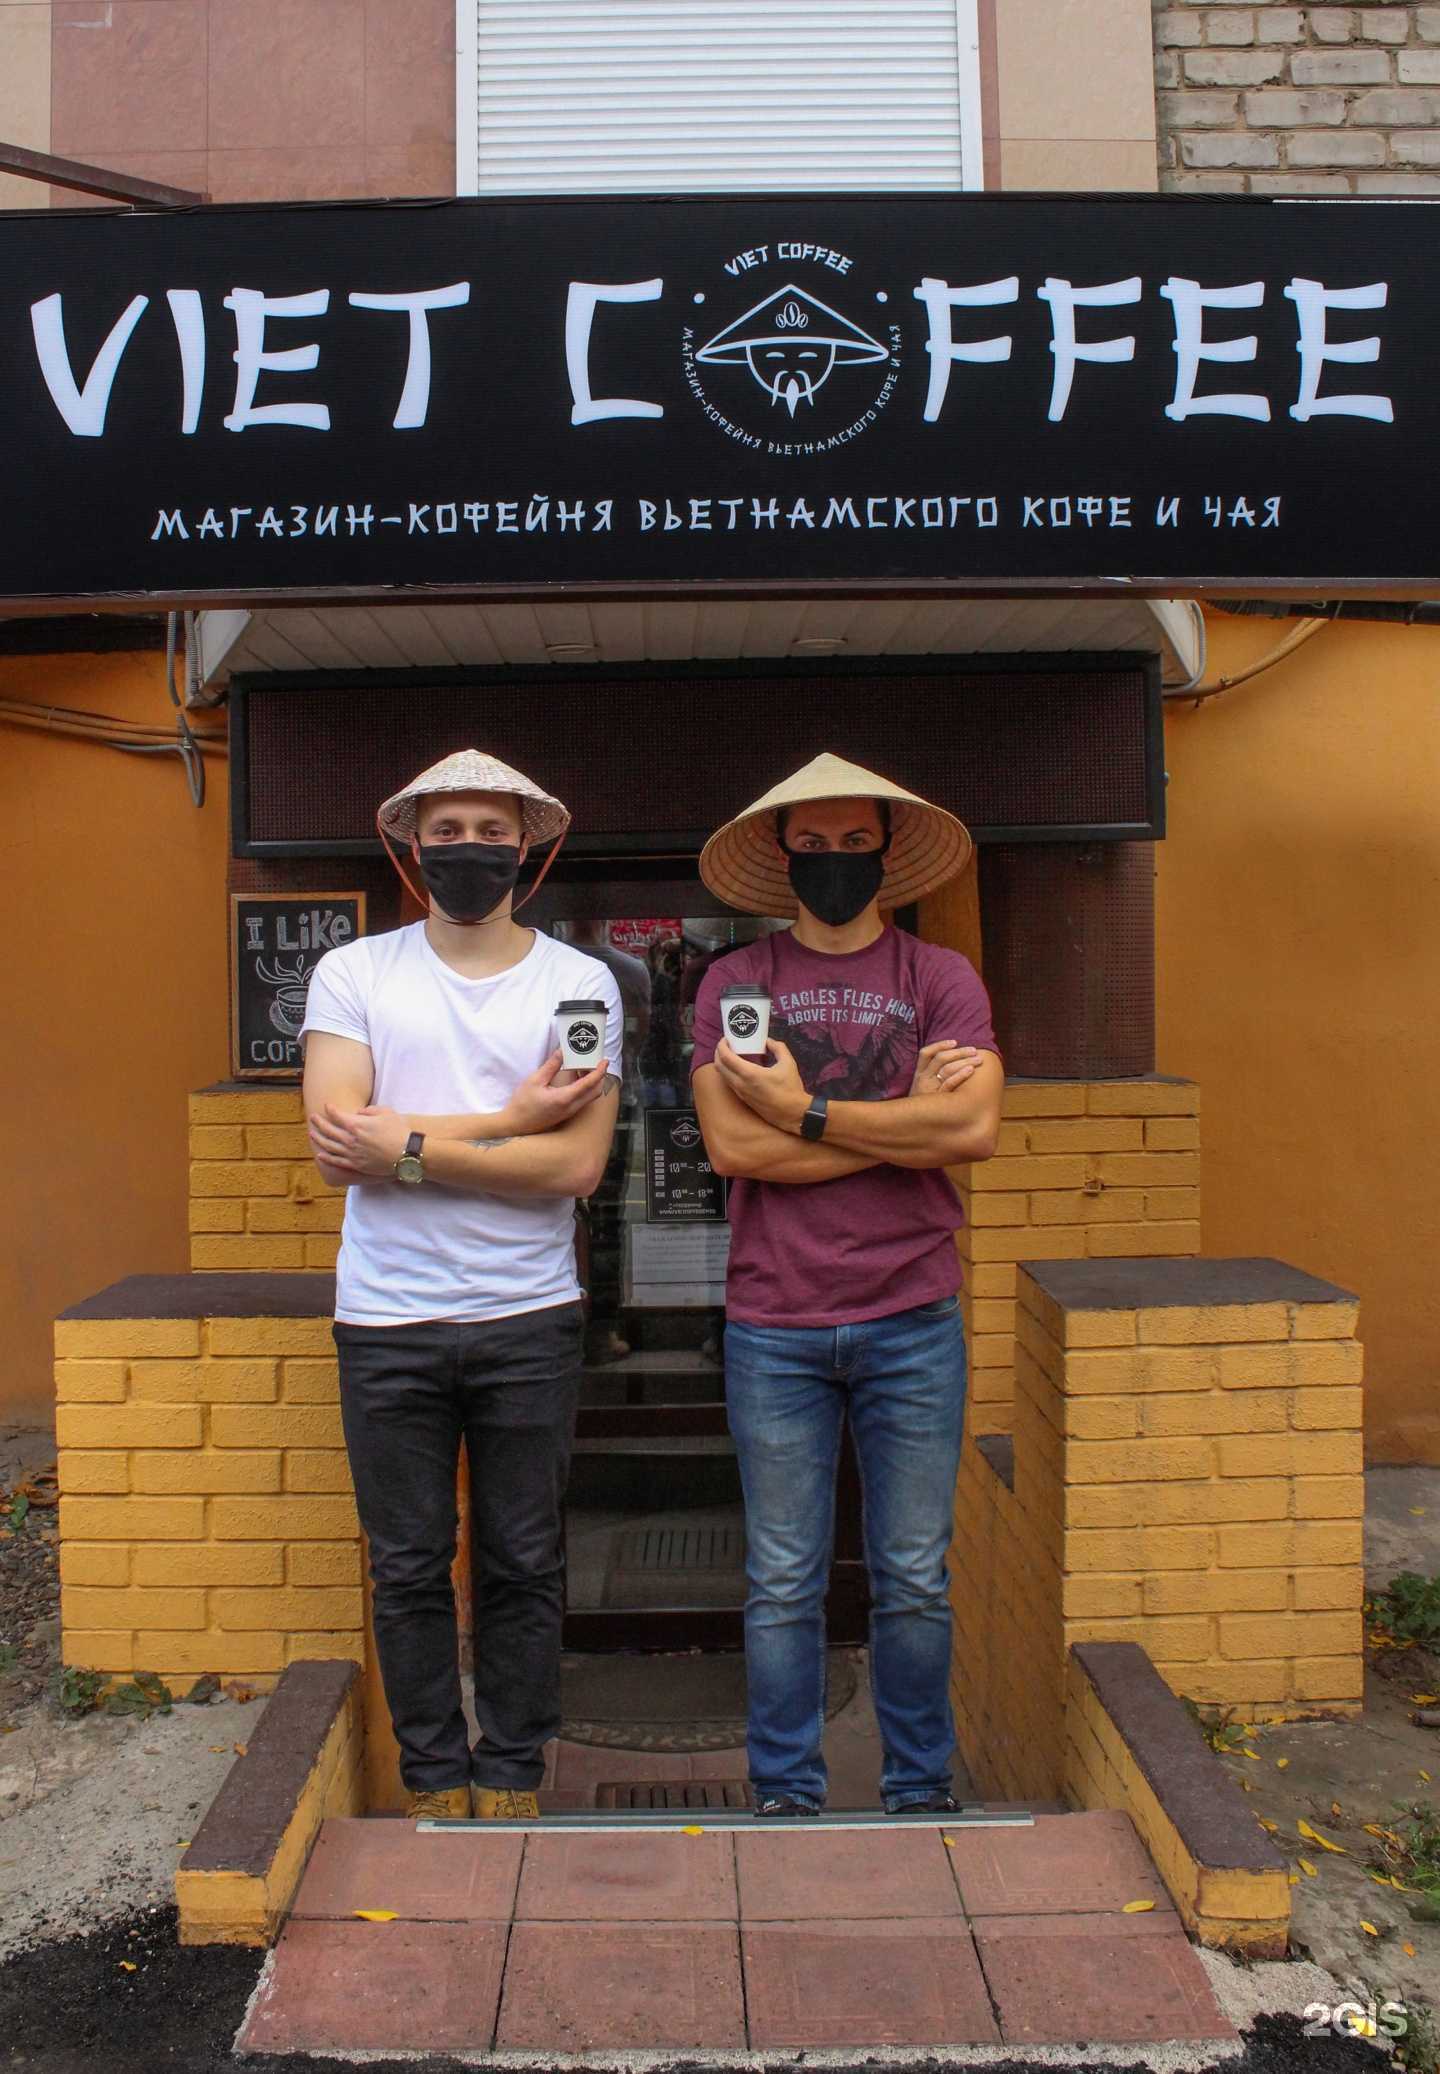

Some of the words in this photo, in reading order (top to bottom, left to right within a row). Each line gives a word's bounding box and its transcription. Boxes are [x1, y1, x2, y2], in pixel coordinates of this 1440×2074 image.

[724, 244, 769, 276] VIET
[777, 242, 854, 275] COFFEE
[889, 324, 902, 353] ЧАЯ
[30, 281, 471, 437] VIET
[890, 358, 902, 368] И
[682, 326, 762, 449] МАГАЗИН-КОФЕЙНЯ
[874, 371, 899, 409] КОФЕ
[767, 409, 878, 455] ВЬЕТНАМСКОГО
[151, 493, 613, 540] МАГАЗИН-КОФЕЙНЯ
[638, 496, 998, 531] ВЬЕТНАМСКОГО
[1023, 496, 1132, 527] КОФЕ
[1156, 496, 1180, 527] И
[1204, 496, 1281, 528] ЧАЯ
[246, 917, 265, 950] I
[780, 988, 837, 1010] EAGLES
[843, 988, 883, 1010] FLIES
[787, 1008, 827, 1026] ABOVE
[831, 1008, 849, 1023] ITS
[852, 1008, 884, 1026] LIMIT
[251, 1039, 305, 1063] COF
